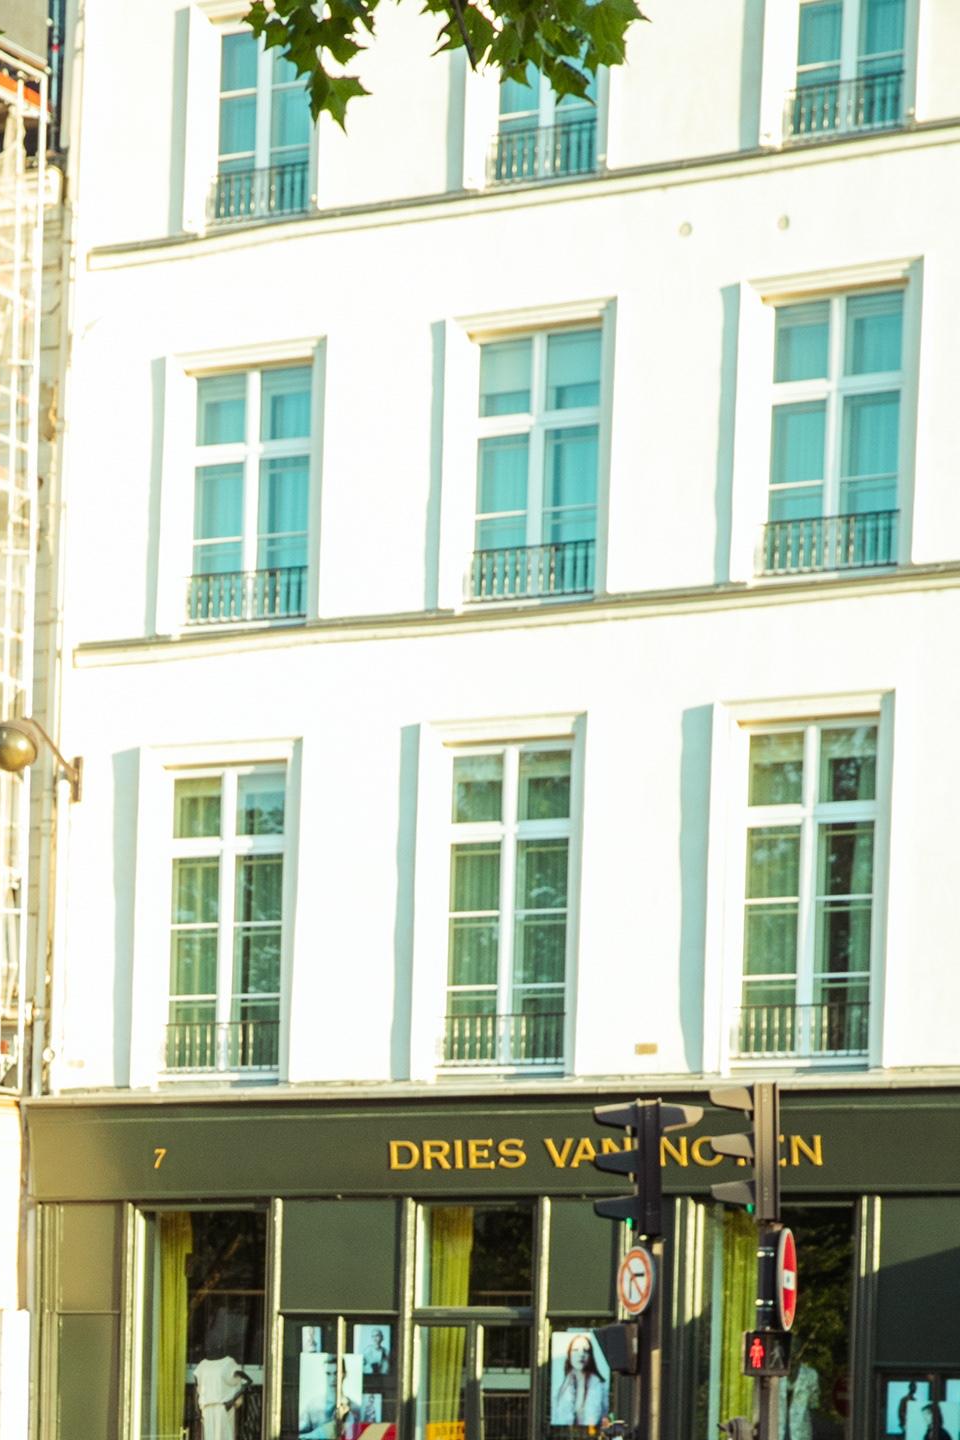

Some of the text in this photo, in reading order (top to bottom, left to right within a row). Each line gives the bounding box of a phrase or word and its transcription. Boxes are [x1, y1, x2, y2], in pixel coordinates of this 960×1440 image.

[154, 1148, 167, 1169] 7
[388, 1138, 527, 1170] DRIES
[659, 1134, 823, 1167] NON
